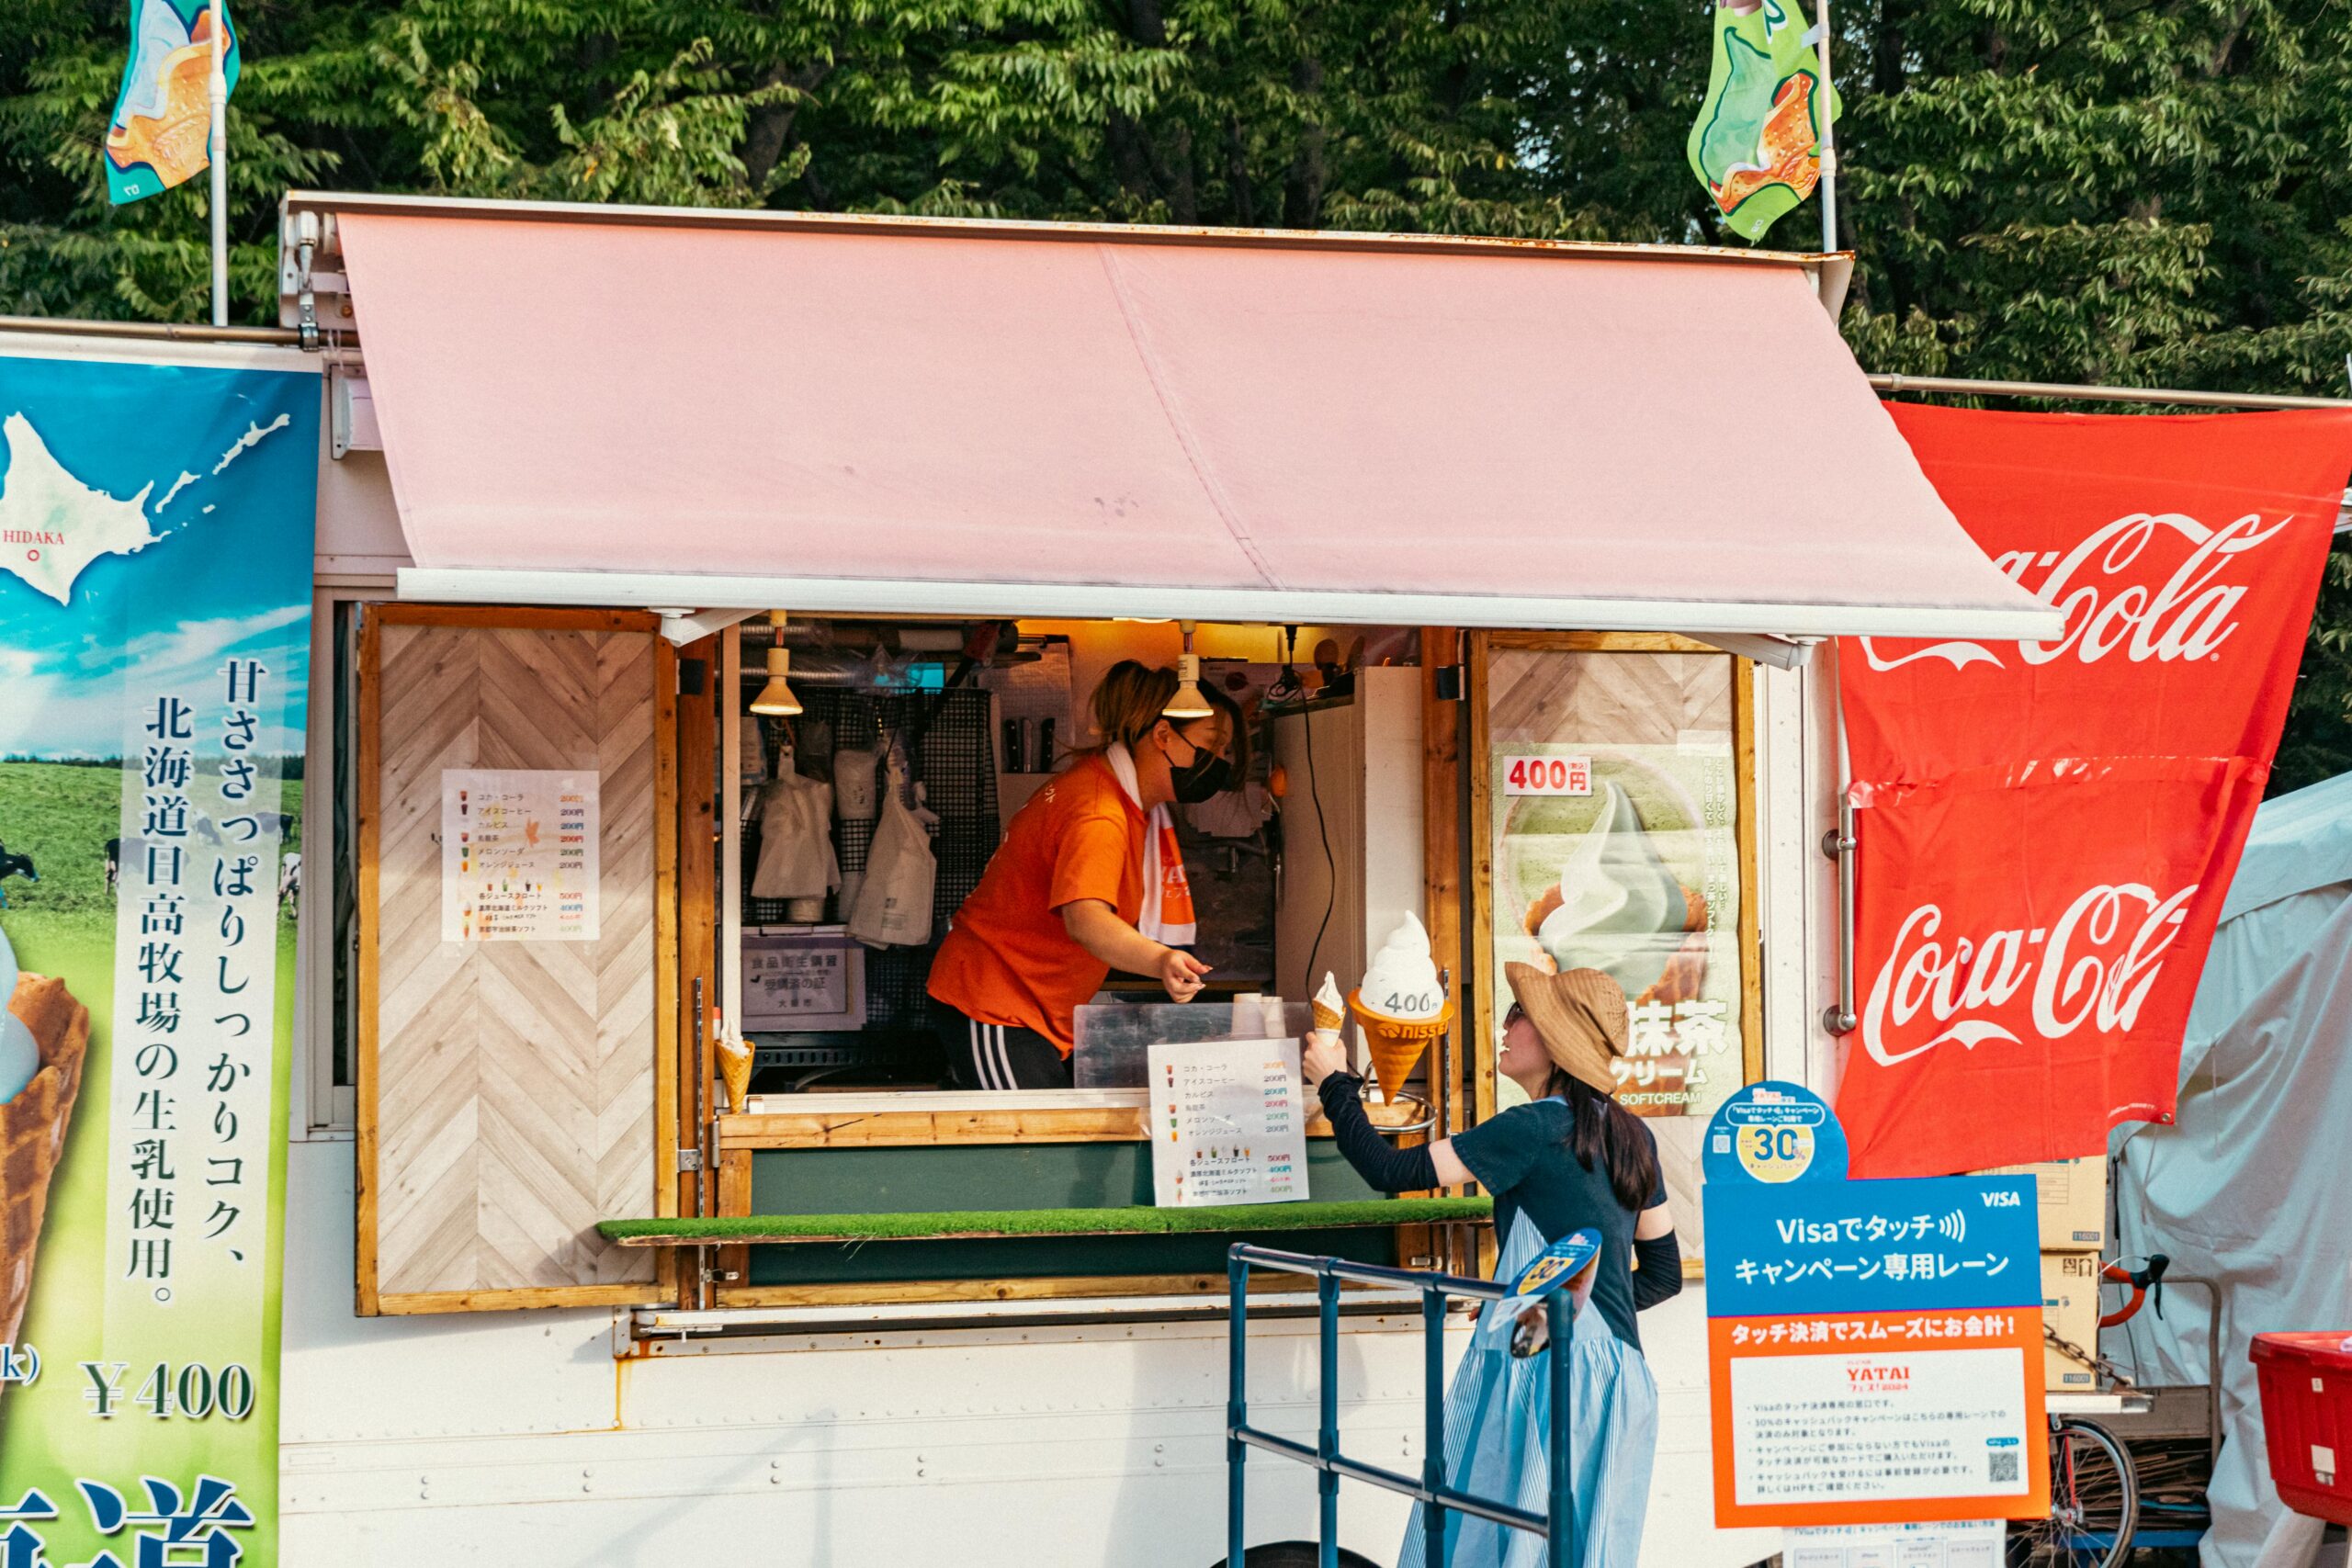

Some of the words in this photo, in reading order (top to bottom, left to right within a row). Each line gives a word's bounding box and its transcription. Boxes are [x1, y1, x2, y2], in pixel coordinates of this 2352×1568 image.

[3, 530, 64, 546] HIDAKA
[205, 660, 267, 1263] 甘ささっぱりしっかりコク、
[127, 696, 195, 1303] 北海道日高牧場の生乳使用。
[1982, 1191, 2021, 1207] VISA
[1735, 1252, 2009, 1285] キャンペーン専用レーン
[1732, 1314, 2016, 1346] タッチ決済でスムーズにお会計!
[81, 1362, 254, 1418] ¥400
[1847, 1367, 1910, 1382] YATAI
